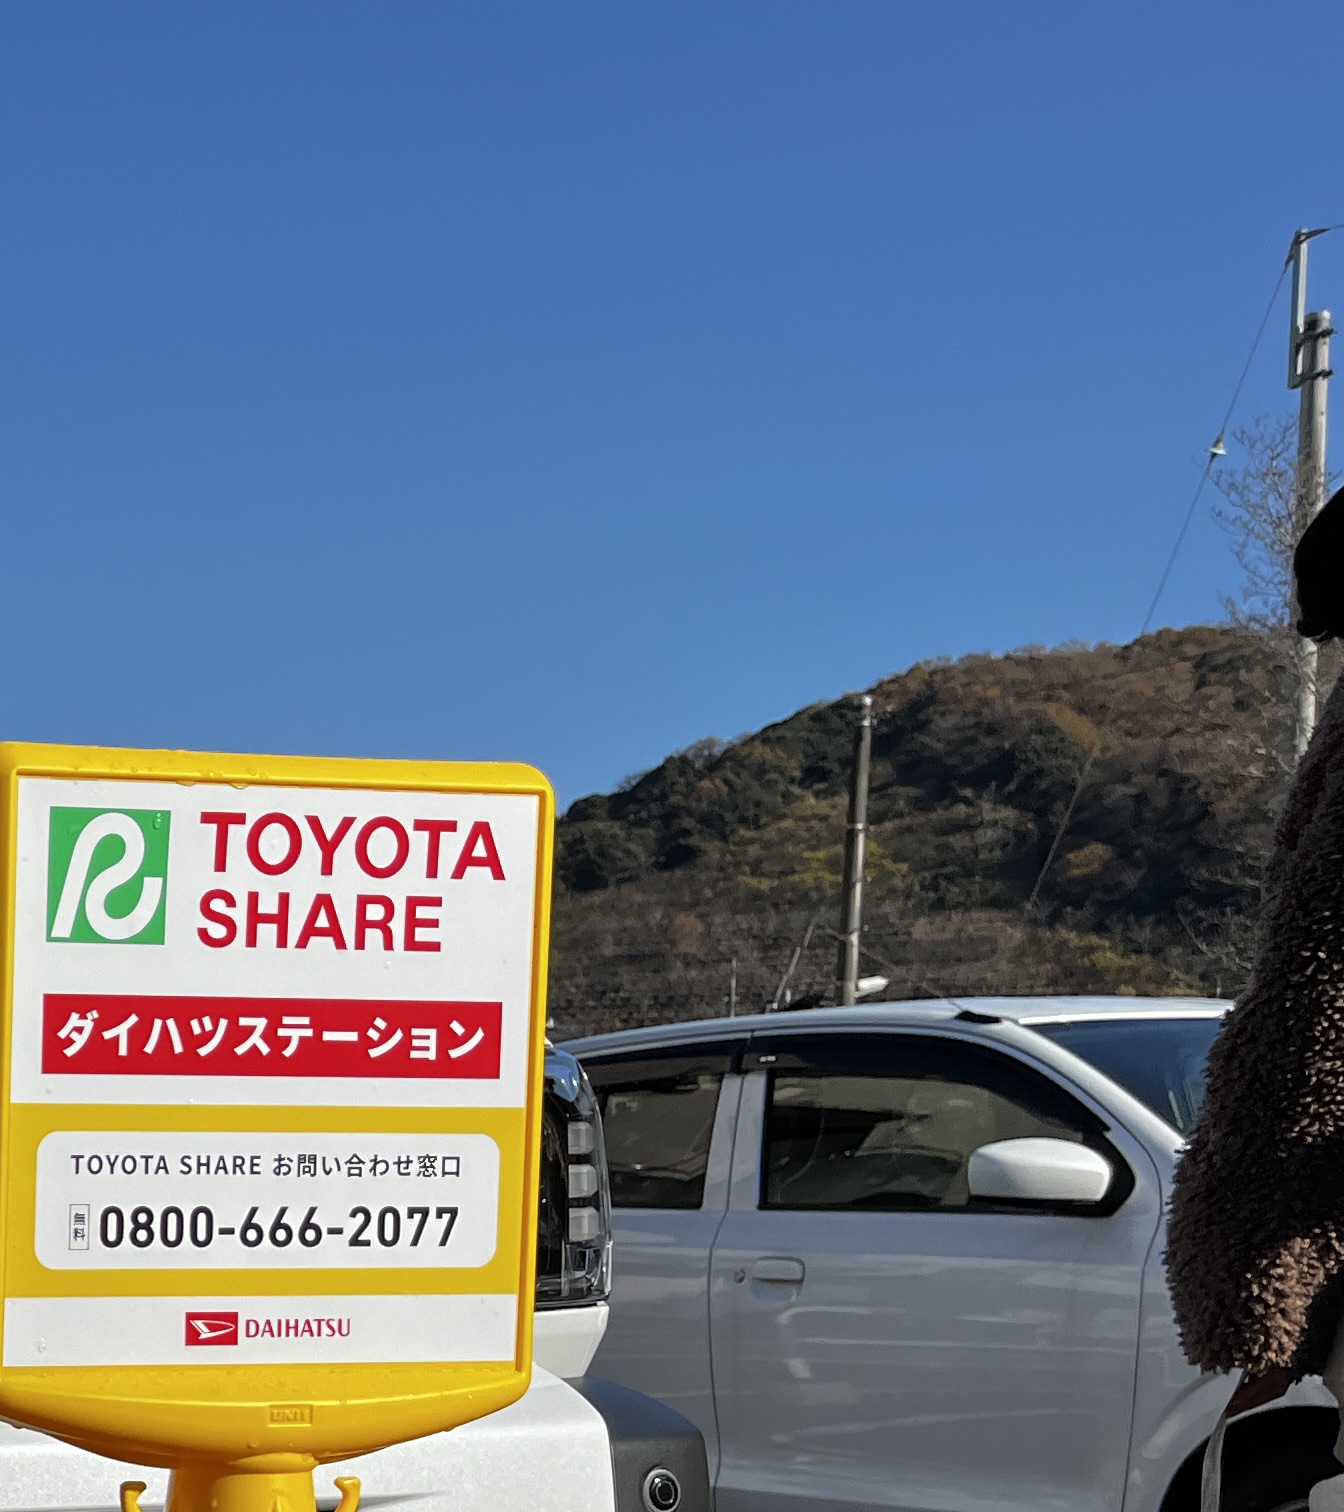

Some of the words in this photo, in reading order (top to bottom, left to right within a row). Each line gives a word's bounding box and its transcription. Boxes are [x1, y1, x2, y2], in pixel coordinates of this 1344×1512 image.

[199, 811, 506, 881] TOYOTA
[197, 888, 442, 953] SHARE
[55, 1010, 486, 1061] ダイハツステーション
[70, 1154, 169, 1176] TOYOTA
[179, 1154, 262, 1176] SHARE
[272, 1153, 461, 1178] お問い合わせ窓口
[99, 1205, 460, 1249] 0800-666-2077
[245, 1317, 351, 1339] DAIHATSU
